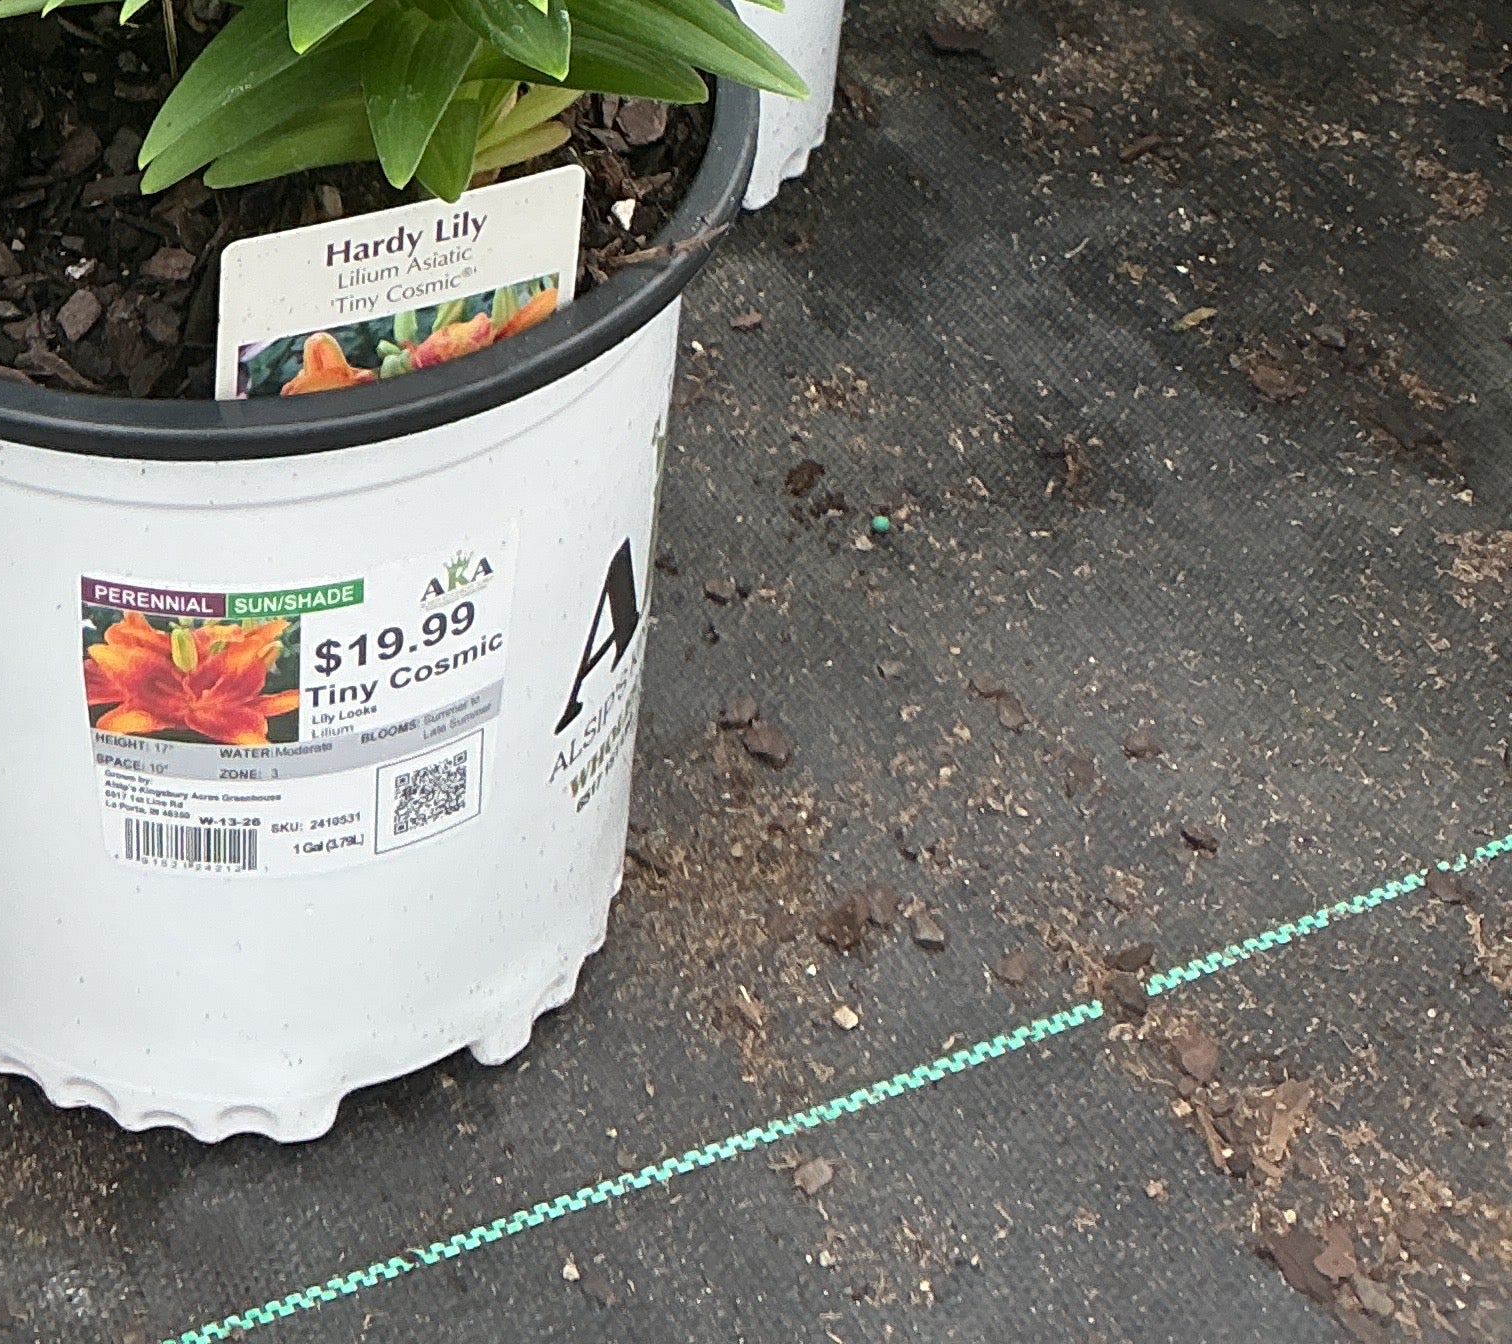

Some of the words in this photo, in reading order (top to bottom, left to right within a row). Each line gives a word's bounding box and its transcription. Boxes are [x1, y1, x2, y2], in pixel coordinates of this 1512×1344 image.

[326, 226, 424, 267] Hardy
[435, 211, 488, 244] Lily
[338, 266, 399, 290] Lilium
[407, 246, 473, 275] Asiatic
[420, 557, 494, 602] AKA
[94, 585, 214, 613] PERENNIAL
[234, 585, 355, 613] SUN/SHADE
[314, 601, 475, 677] $19.99
[554, 536, 640, 736] A
[305, 679, 379, 708] Tiny
[390, 633, 503, 689] Cosmic
[219, 748, 274, 760] WATER:
[275, 741, 333, 758] Moderate
[424, 699, 468, 725] Summer
[312, 713, 335, 726] Lily
[339, 705, 377, 720] Looks
[95, 732, 151, 751] HEIGHT:
[311, 724, 355, 740] Lilium
[96, 753, 146, 771] SPACE:
[219, 769, 262, 780] ZONE:
[271, 822, 303, 833] SKU:
[303, 841, 324, 853] Gal
